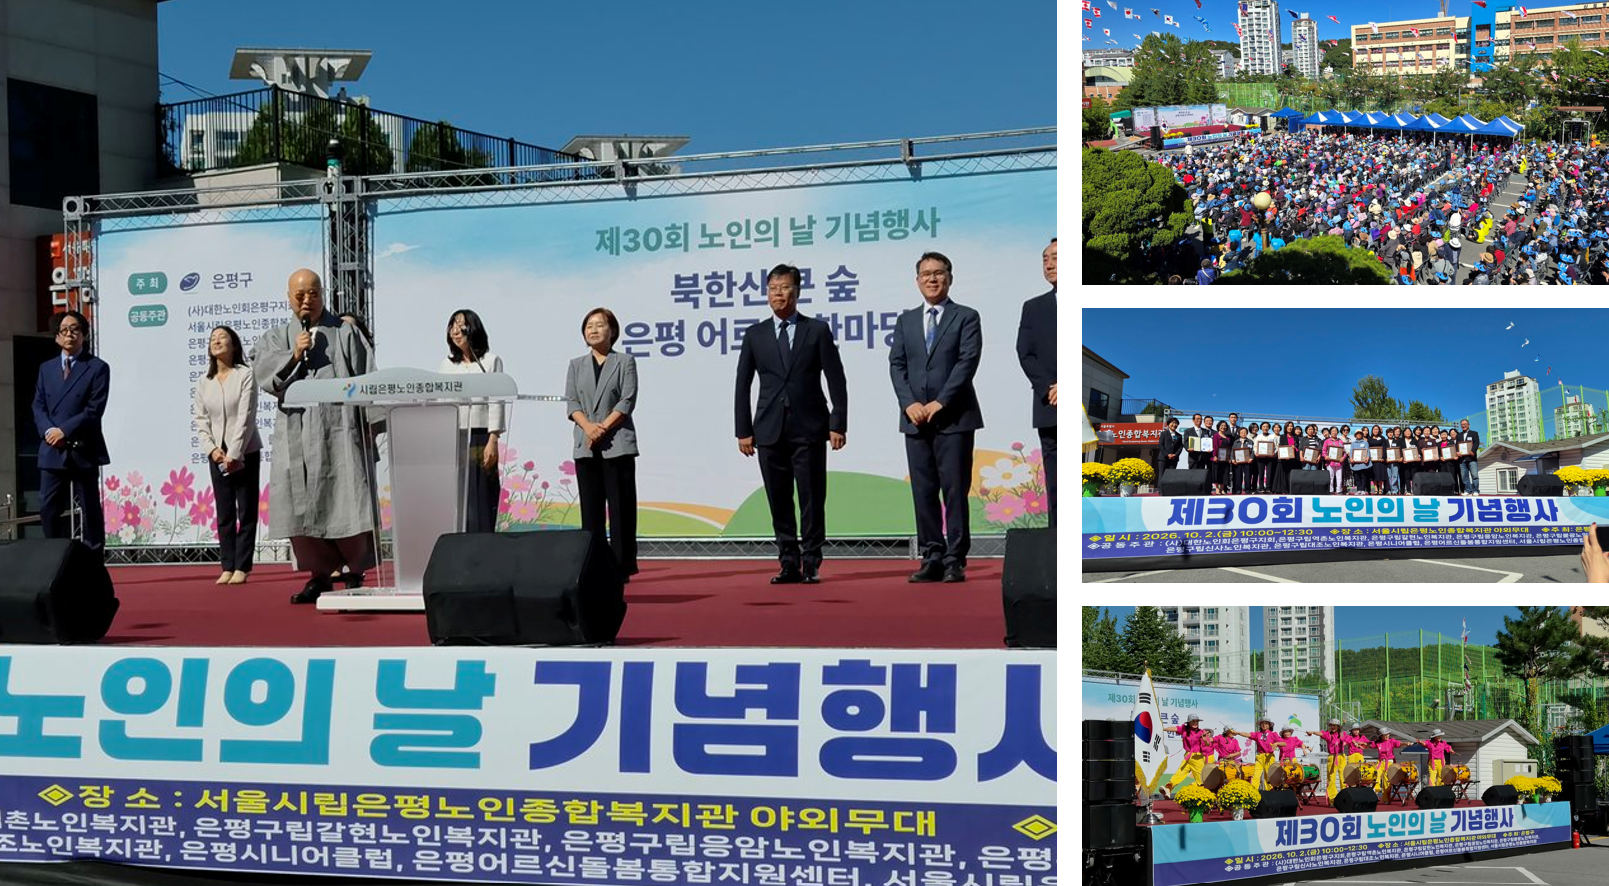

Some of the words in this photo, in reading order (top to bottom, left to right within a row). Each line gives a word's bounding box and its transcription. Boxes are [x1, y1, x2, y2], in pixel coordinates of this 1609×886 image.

[595, 221, 690, 256] 제30회
[698, 217, 780, 250] 노인의
[789, 214, 817, 245] 날
[825, 206, 941, 244] 기념행사
[136, 278, 145, 290] 주
[150, 277, 159, 289] 최
[212, 272, 253, 290] 은평구
[671, 268, 768, 309] 북한산
[825, 265, 859, 303] 숲
[130, 310, 166, 323] 공동주관
[188, 301, 292, 317] (사)대한노인회은평구지
[621, 318, 686, 358] 은평
[360, 381, 463, 395] 시립은평노인종합복지관
[1167, 496, 1303, 526] 제30회
[1312, 497, 1404, 523] 노인의
[1413, 498, 1440, 523] 날
[1449, 497, 1560, 523] 기념행사
[1104, 534, 1115, 542] 일
[1119, 534, 1131, 542] 시
[1142, 532, 1181, 541] 2026.
[1240, 529, 1313, 537] 10:00~12:30
[1166, 542, 1272, 553] 은평구립신사노인복지관,
[0, 656, 336, 766] 노인의
[370, 659, 496, 769] 날
[1107, 693, 1136, 704] 제30회
[1162, 697, 1169, 707] 날
[1170, 697, 1198, 708] 기념행사
[1170, 713, 1179, 725] 숲
[78, 785, 115, 808] 장
[125, 787, 161, 809] 소
[194, 789, 739, 829] 서울시립은평노인종합복지관
[751, 805, 936, 837] 야외무대
[1275, 815, 1362, 847] 제30회
[1367, 812, 1424, 839] 노인의
[1430, 811, 1447, 834] 날
[1450, 807, 1514, 832] 기념행사
[0, 810, 186, 839] 촌노인복지관,
[193, 817, 552, 853] 은평구립갈현노인복지관,
[561, 830, 967, 870] 은평구립응암노인복지관,
[978, 845, 1057, 871] 은평
[1261, 853, 1285, 861] 2026.
[1322, 844, 1368, 854] 10:00~12:30
[180, 840, 403, 872] 은평시니어클럽,
[412, 849, 872, 886] 은평어르신돌봄통합지원센터,
